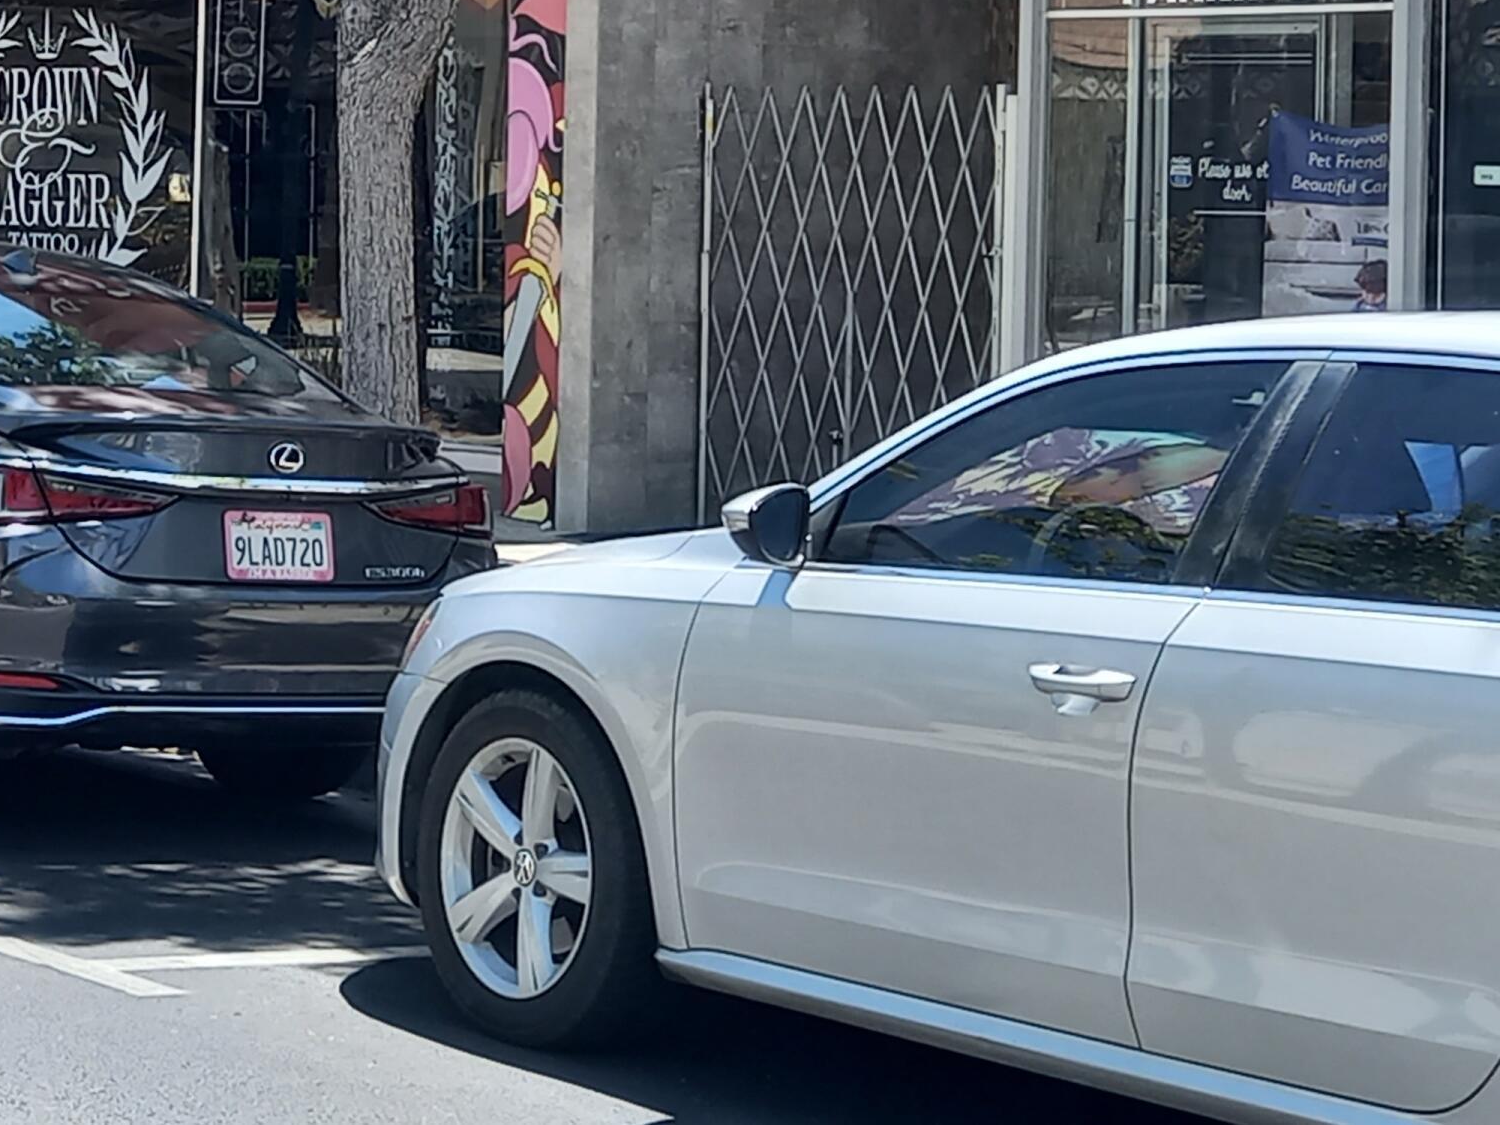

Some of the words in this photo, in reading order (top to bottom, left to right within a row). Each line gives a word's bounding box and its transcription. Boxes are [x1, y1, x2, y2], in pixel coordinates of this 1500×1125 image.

[1310, 129, 1388, 148] Waterproo
[1308, 152, 1331, 169] Pet
[1335, 152, 1388, 170] Friendl
[1291, 174, 1356, 197] Beautiful
[1360, 178, 1388, 195] Car
[7, 231, 80, 254] TATTOO
[235, 536, 324, 567] 9LAD720
